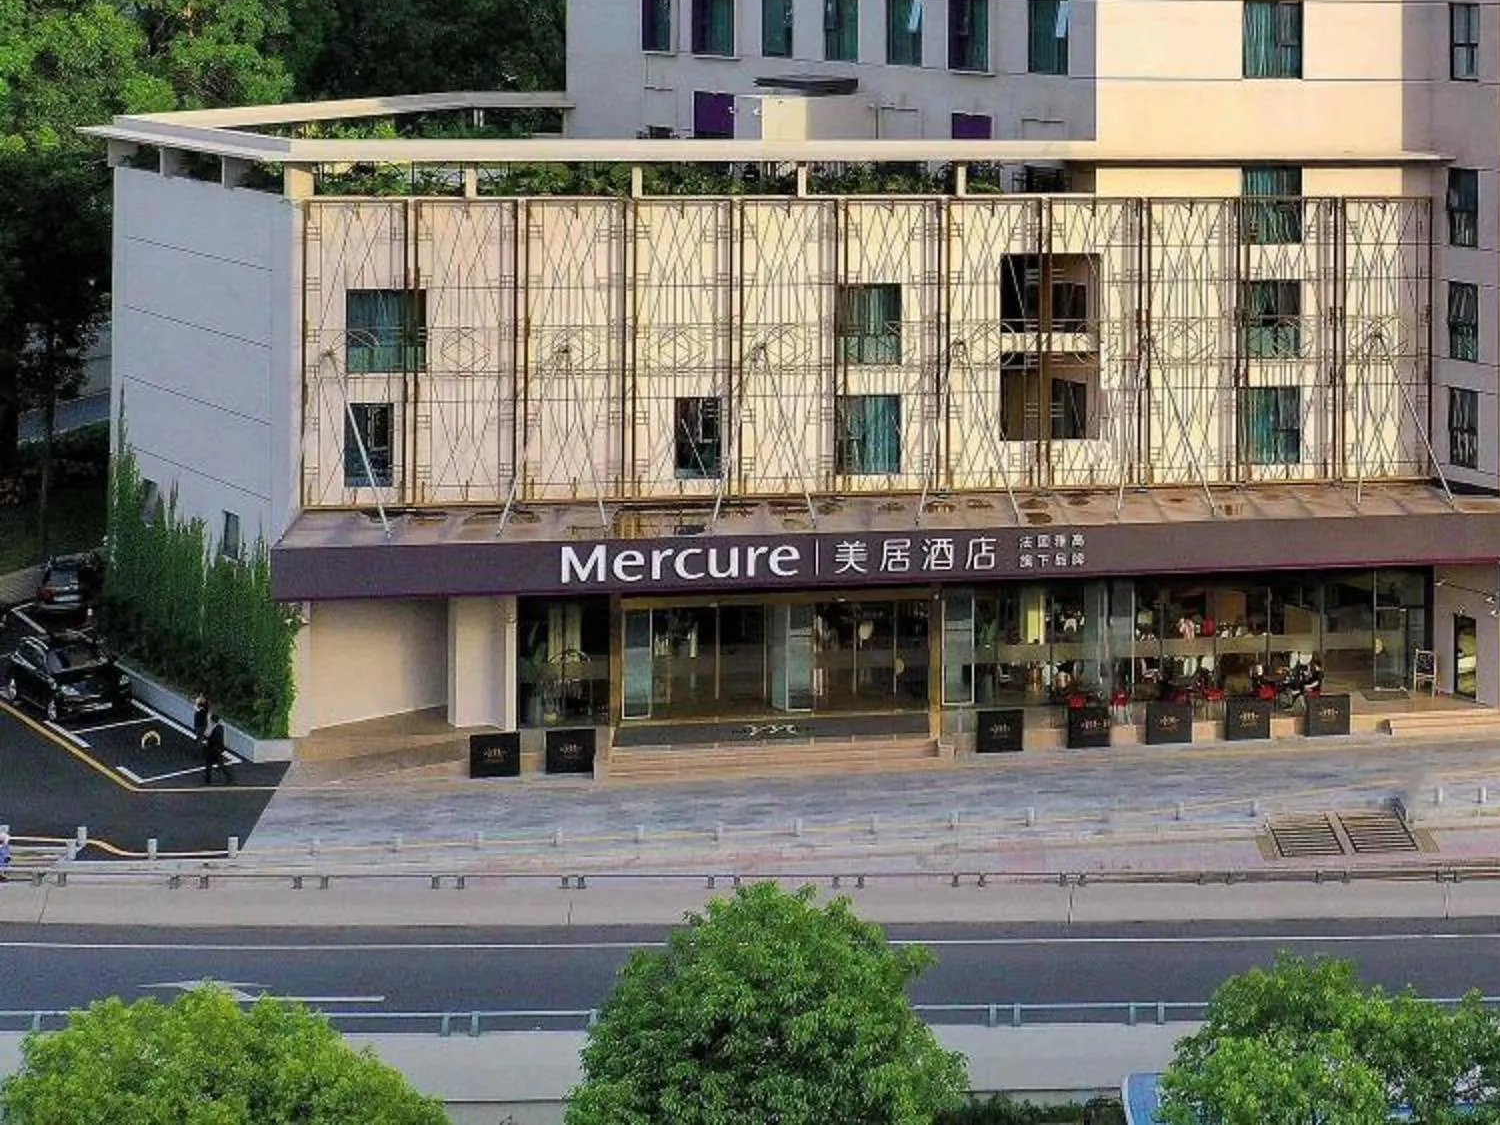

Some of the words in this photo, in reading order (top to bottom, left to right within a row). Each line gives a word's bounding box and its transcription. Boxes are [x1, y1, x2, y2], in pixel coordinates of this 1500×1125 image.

[560, 544, 800, 584] Mercure
[833, 536, 998, 575] 美居酒店
